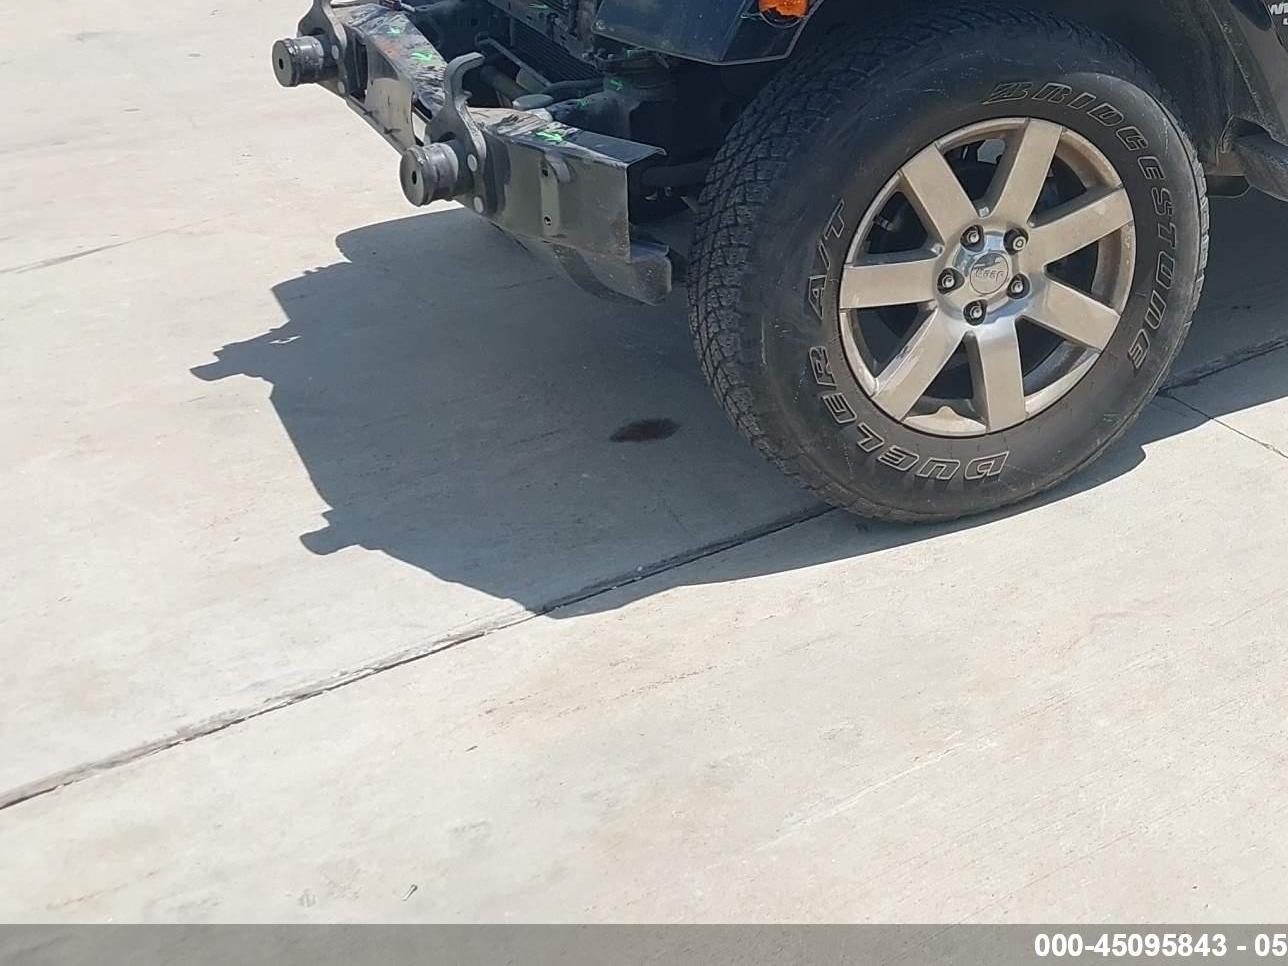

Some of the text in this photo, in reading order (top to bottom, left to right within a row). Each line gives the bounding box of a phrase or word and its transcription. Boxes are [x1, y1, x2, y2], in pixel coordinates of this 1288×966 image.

[807, 199, 1010, 480] DUELER A/T
[981, 81, 1177, 370] BRIDGESTONE
